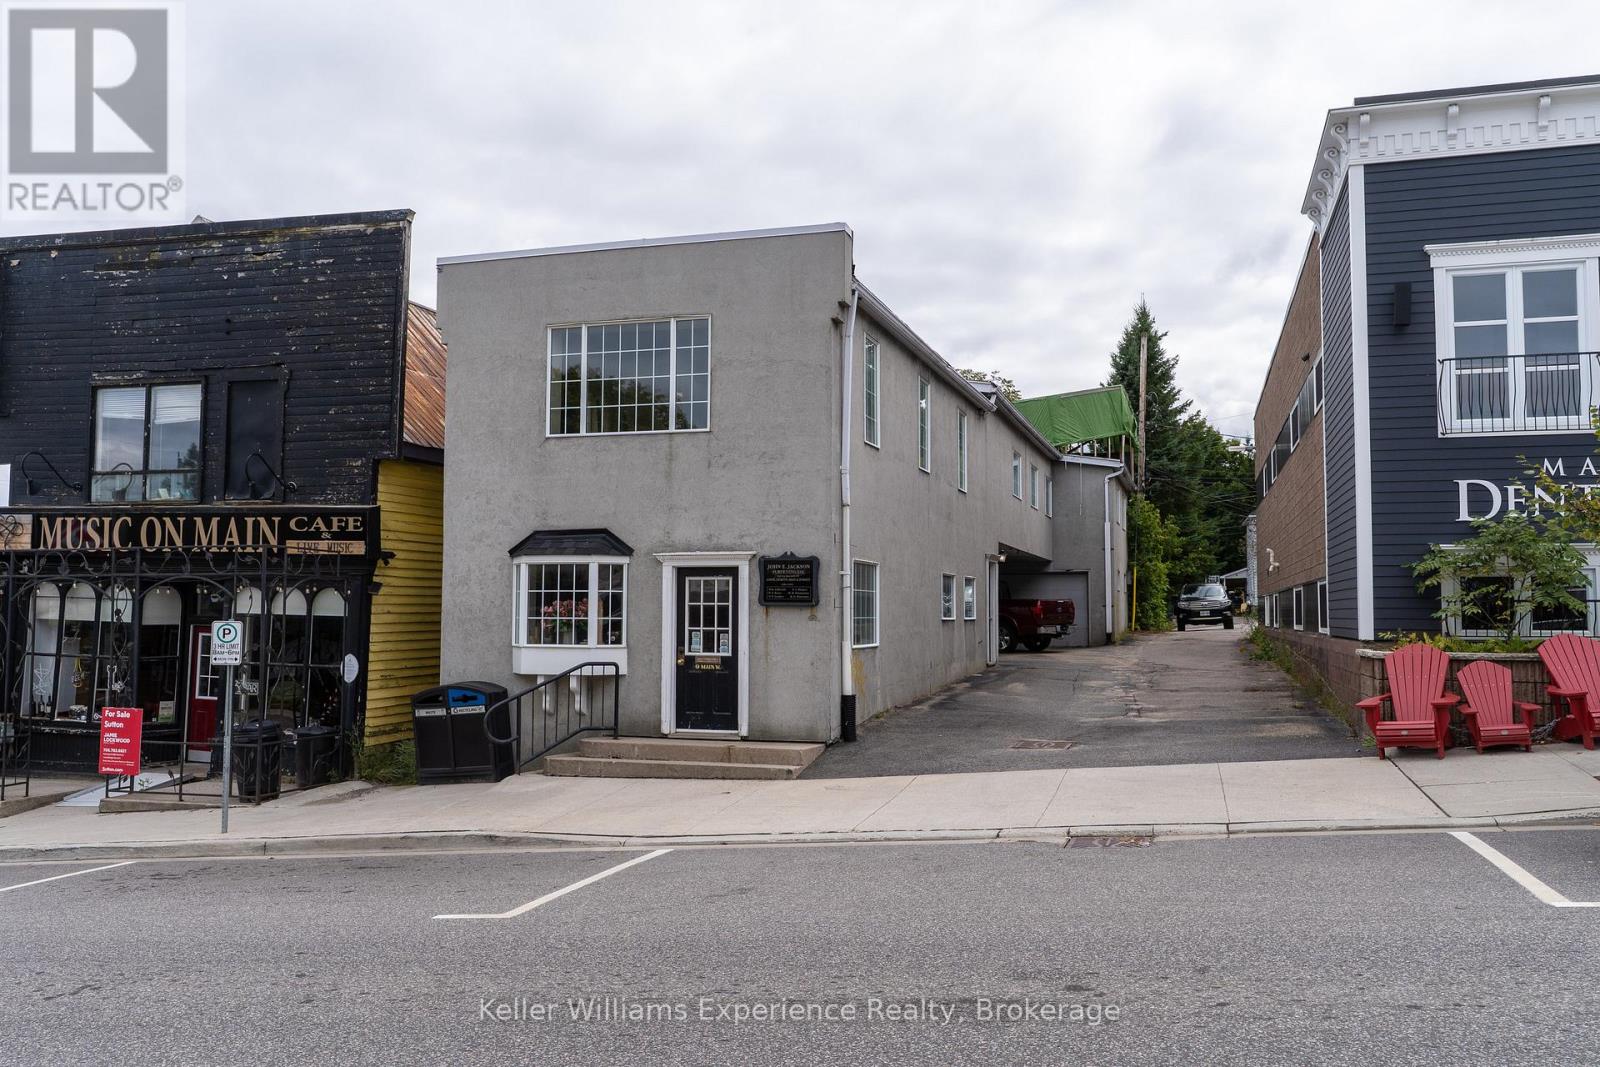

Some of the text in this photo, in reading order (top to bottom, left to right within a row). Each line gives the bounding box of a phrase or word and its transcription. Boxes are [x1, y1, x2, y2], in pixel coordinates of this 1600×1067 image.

[289, 516, 364, 532] CAFE
[39, 516, 281, 553] MUSIC ON MAIN
[320, 531, 332, 539] &
[327, 542, 353, 554] MUSIC
[222, 627, 232, 639] P
[104, 710, 131, 719] For Sale
[104, 720, 125, 729] Sutton
